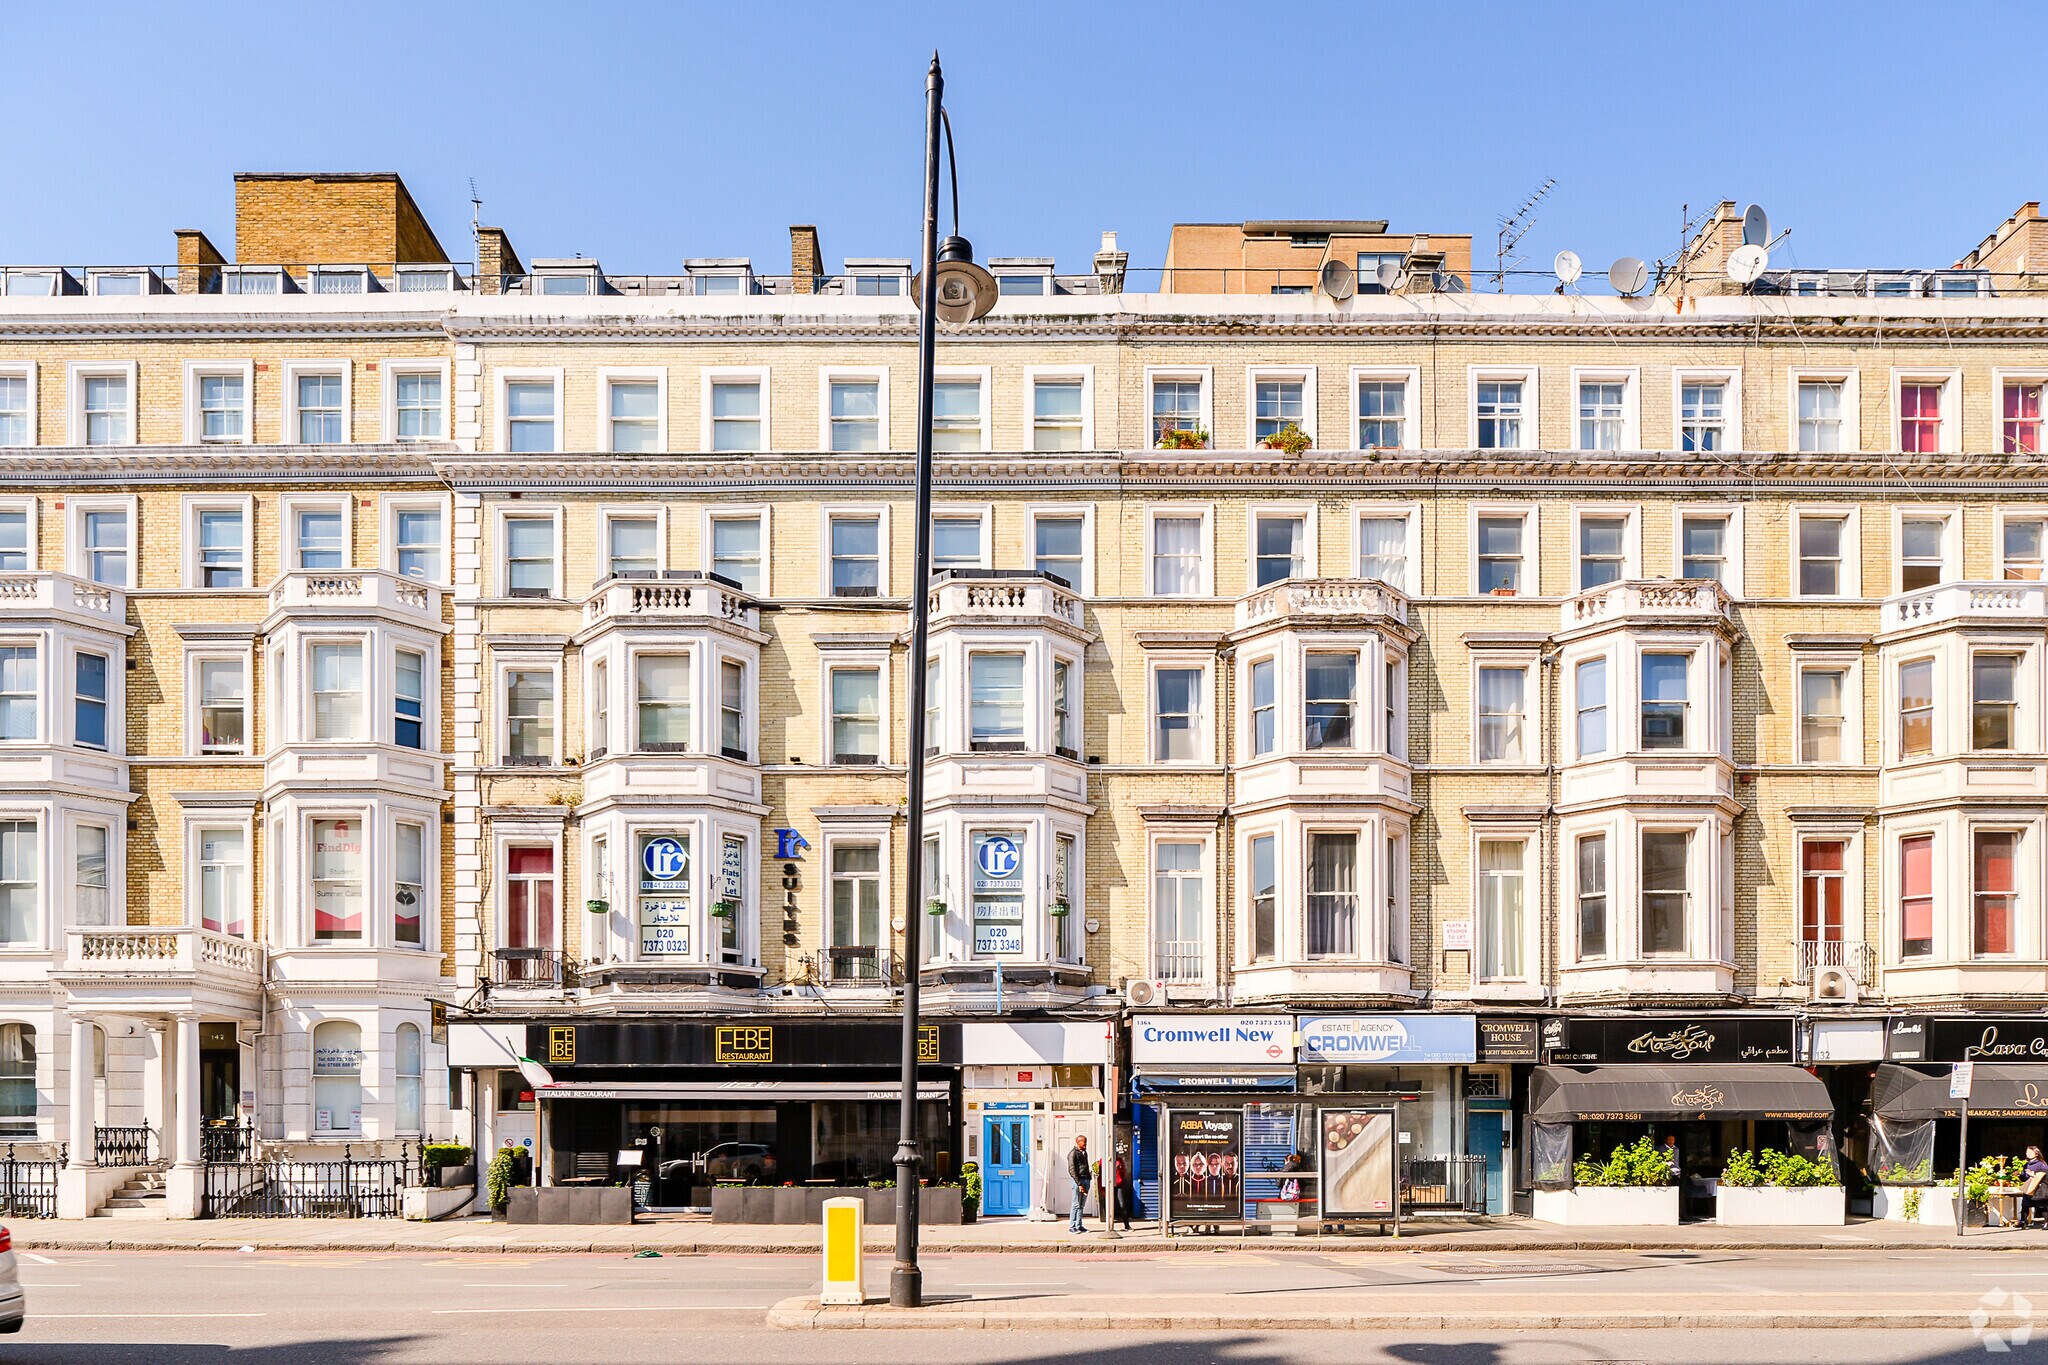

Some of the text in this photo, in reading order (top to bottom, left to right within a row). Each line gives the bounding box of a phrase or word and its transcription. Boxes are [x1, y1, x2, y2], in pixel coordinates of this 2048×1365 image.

[722, 868, 740, 878] Flats
[725, 887, 737, 895] Let
[656, 929, 674, 938] 020
[989, 928, 1007, 937] 020
[643, 940, 687, 952] 7373 0323
[976, 940, 1020, 951] 7373 3348
[1322, 1024, 1394, 1032] ESTATE AGENCY
[1480, 1024, 1532, 1032] CROMWELL
[1143, 1027, 1274, 1042] Cromwell New
[1490, 1033, 1522, 1041] HOUSE
[719, 1029, 770, 1059] FEBE
[1307, 1035, 1422, 1052] CROMWELL
[1969, 1026, 2028, 1056] Lava
[1741, 1046, 1789, 1059] مطعم عراقي
[1816, 1051, 1830, 1060] 132
[1178, 1077, 1230, 1085] CROMWELL
[867, 1091, 939, 1099] ITALIAN RURANT
[1764, 1111, 1830, 1120] www.masgouf.com
[1180, 1120, 1233, 1131] ABBA Voyage
